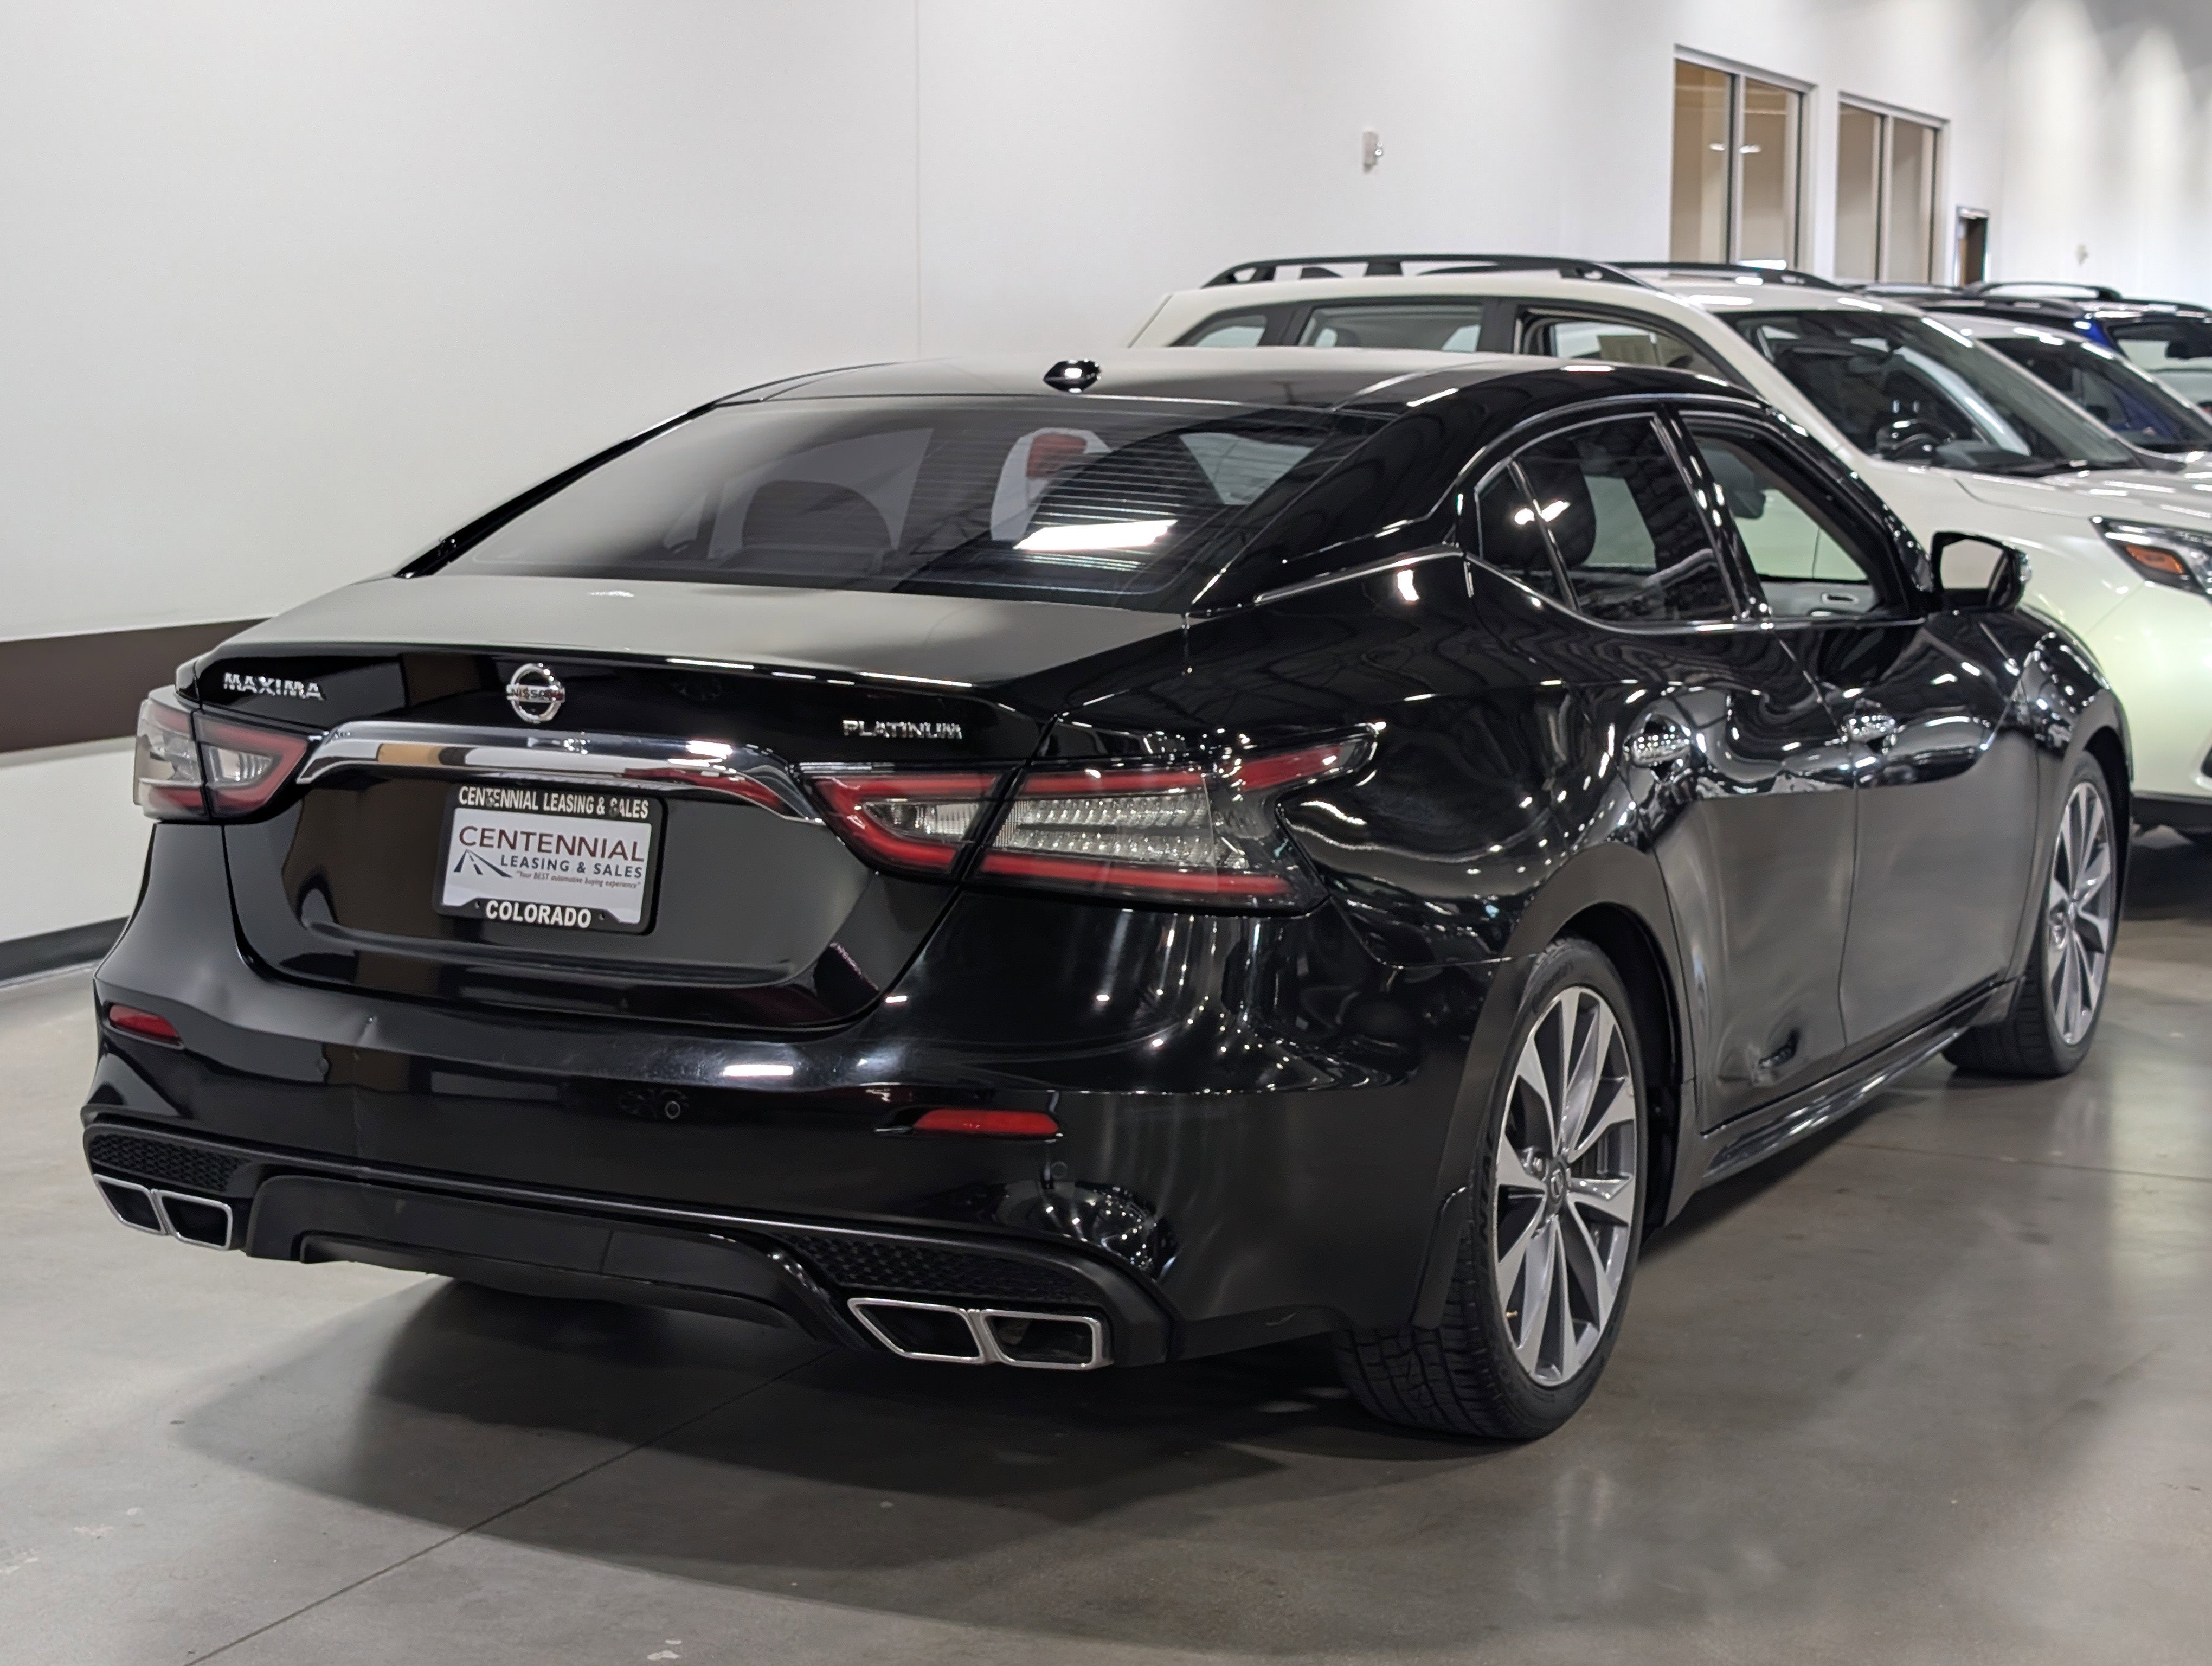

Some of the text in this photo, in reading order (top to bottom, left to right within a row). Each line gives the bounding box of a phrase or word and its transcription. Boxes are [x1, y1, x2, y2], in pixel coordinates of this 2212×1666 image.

[223, 672, 325, 701] MAXIMA
[843, 720, 962, 739] PLATINUM
[459, 786, 538, 810] CENTENNIAL
[543, 792, 595, 814] LEASING
[596, 796, 605, 815] &
[459, 826, 644, 862] CENTENNIAL
[501, 854, 642, 878] LEASING & SALES
[585, 877, 603, 887] buying
[486, 900, 591, 928] COLORADO
